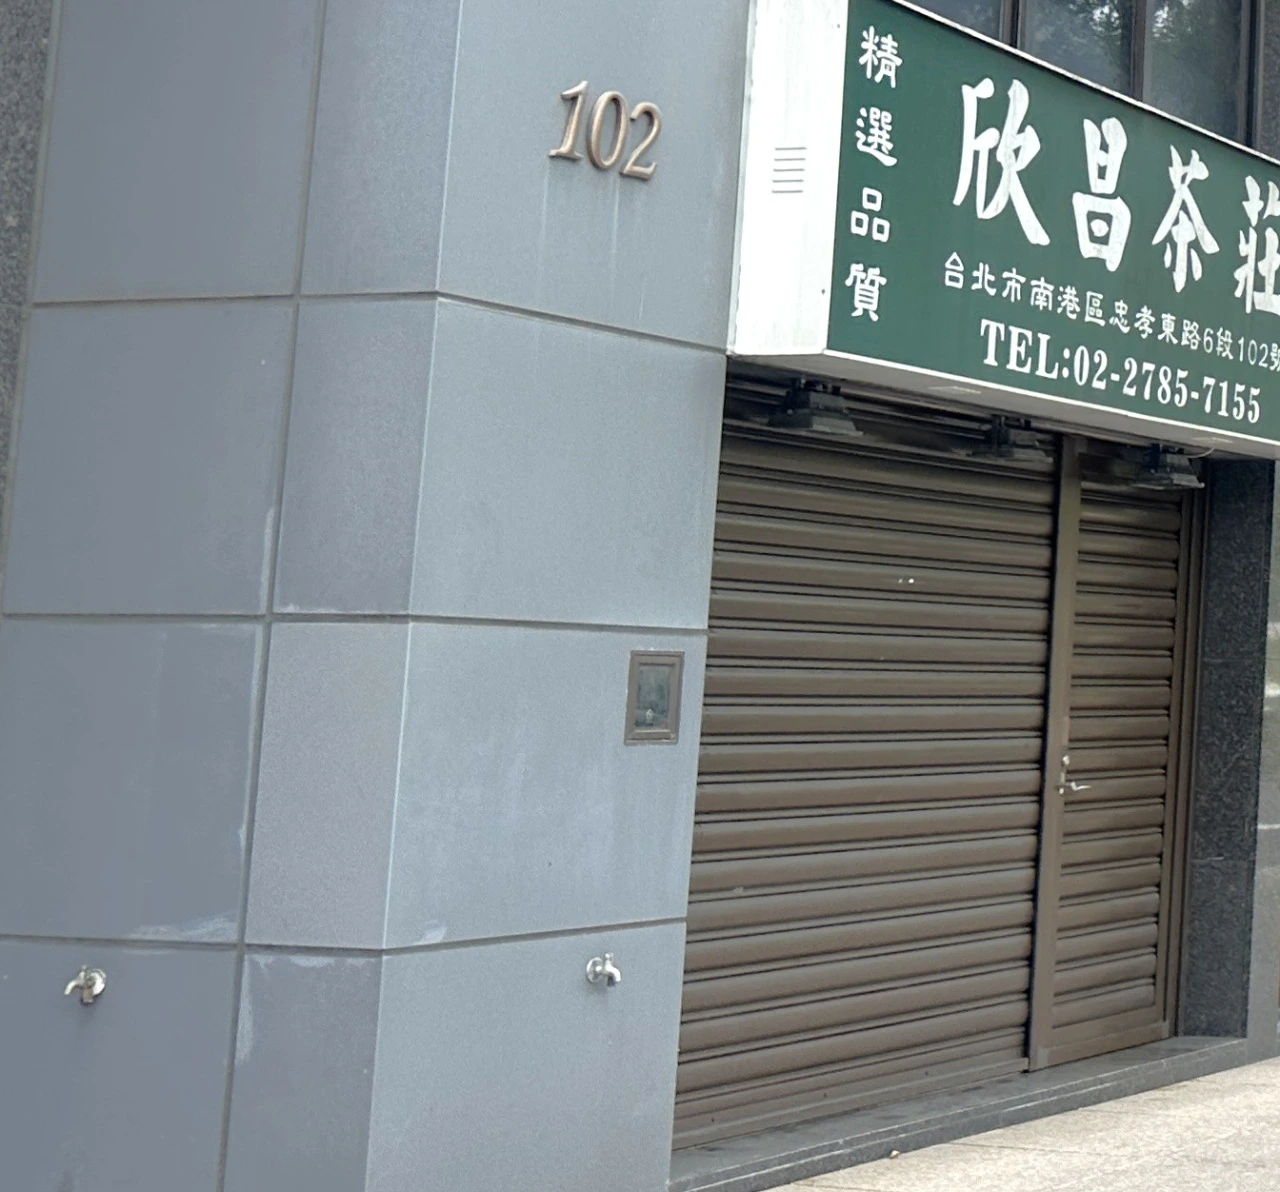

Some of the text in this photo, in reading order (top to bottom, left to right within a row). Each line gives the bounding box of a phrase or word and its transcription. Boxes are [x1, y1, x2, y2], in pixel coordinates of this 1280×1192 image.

[548, 79, 663, 181] 102
[844, 25, 903, 323] 精選品質
[980, 318, 1262, 424] TEL:02-2785-7155
